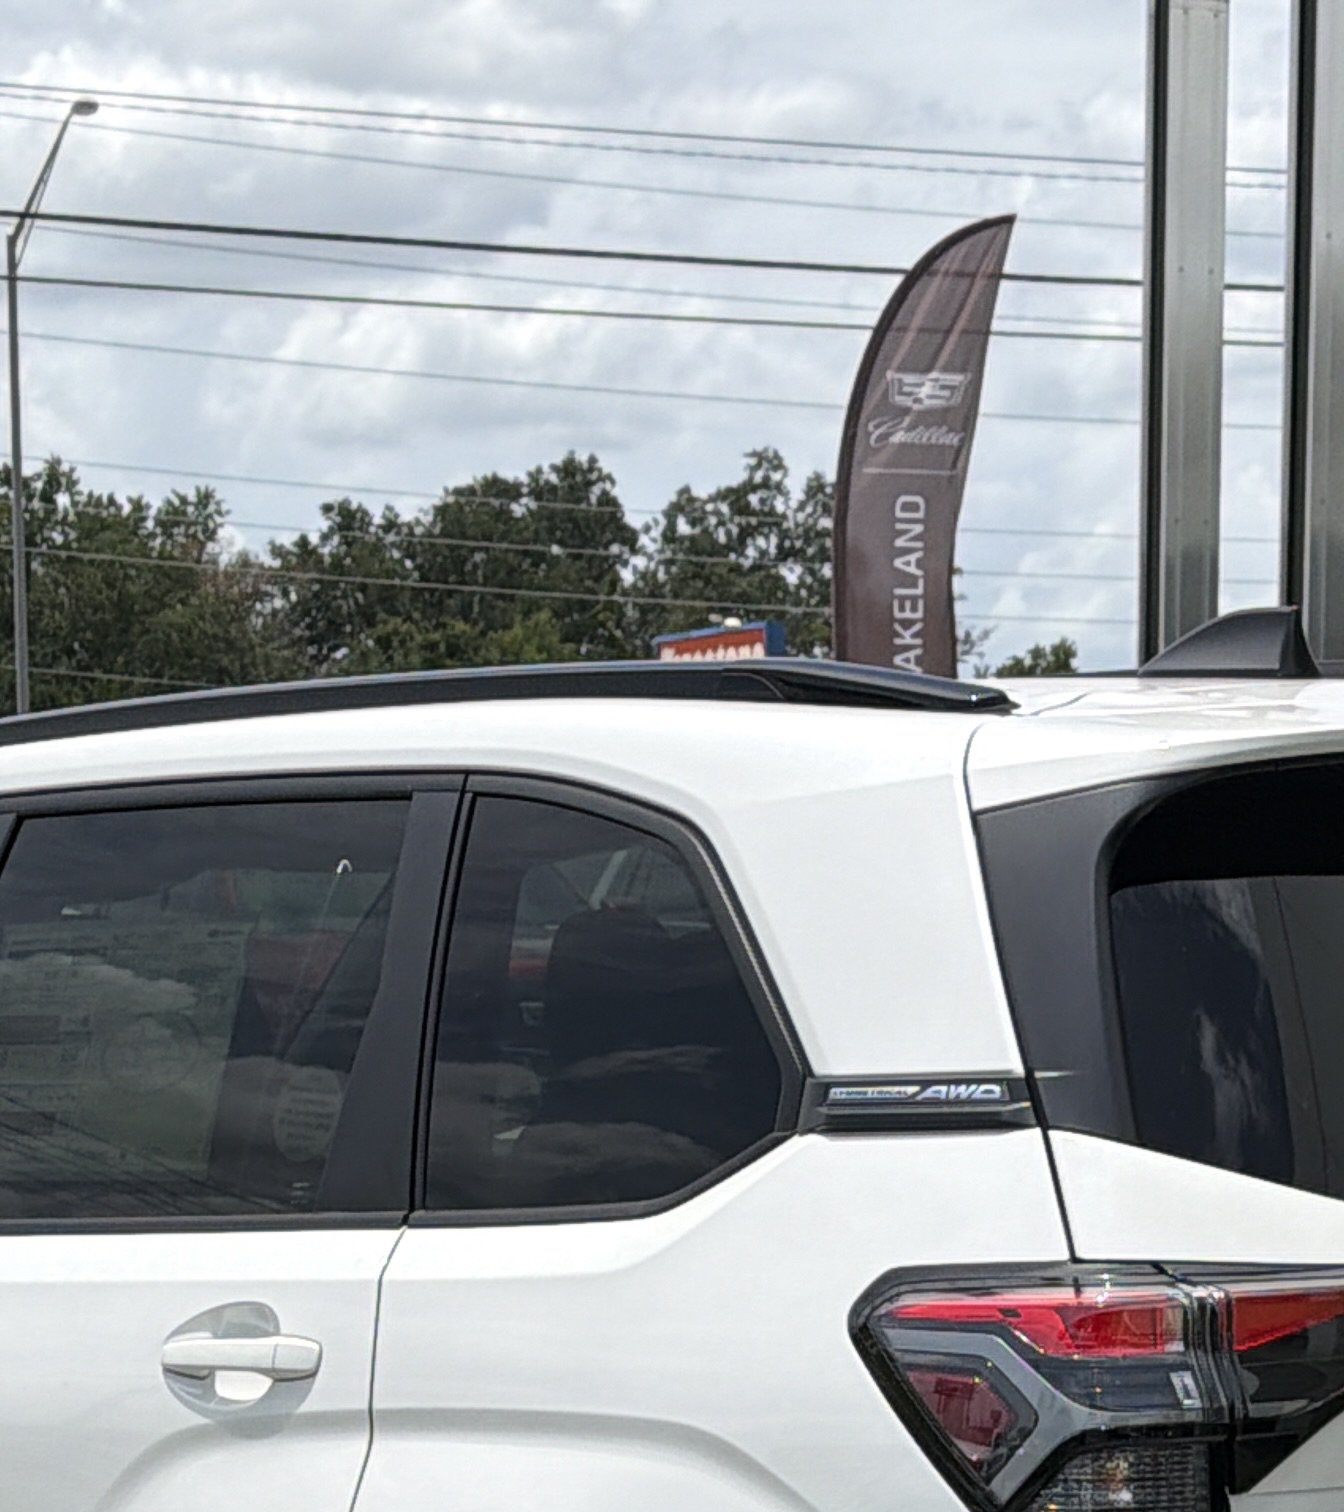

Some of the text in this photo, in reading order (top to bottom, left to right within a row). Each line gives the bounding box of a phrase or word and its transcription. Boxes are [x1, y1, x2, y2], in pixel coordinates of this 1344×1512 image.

[867, 416, 965, 448] Cadillac
[892, 494, 926, 674] AKELAND
[915, 1082, 1003, 1101] AWD
